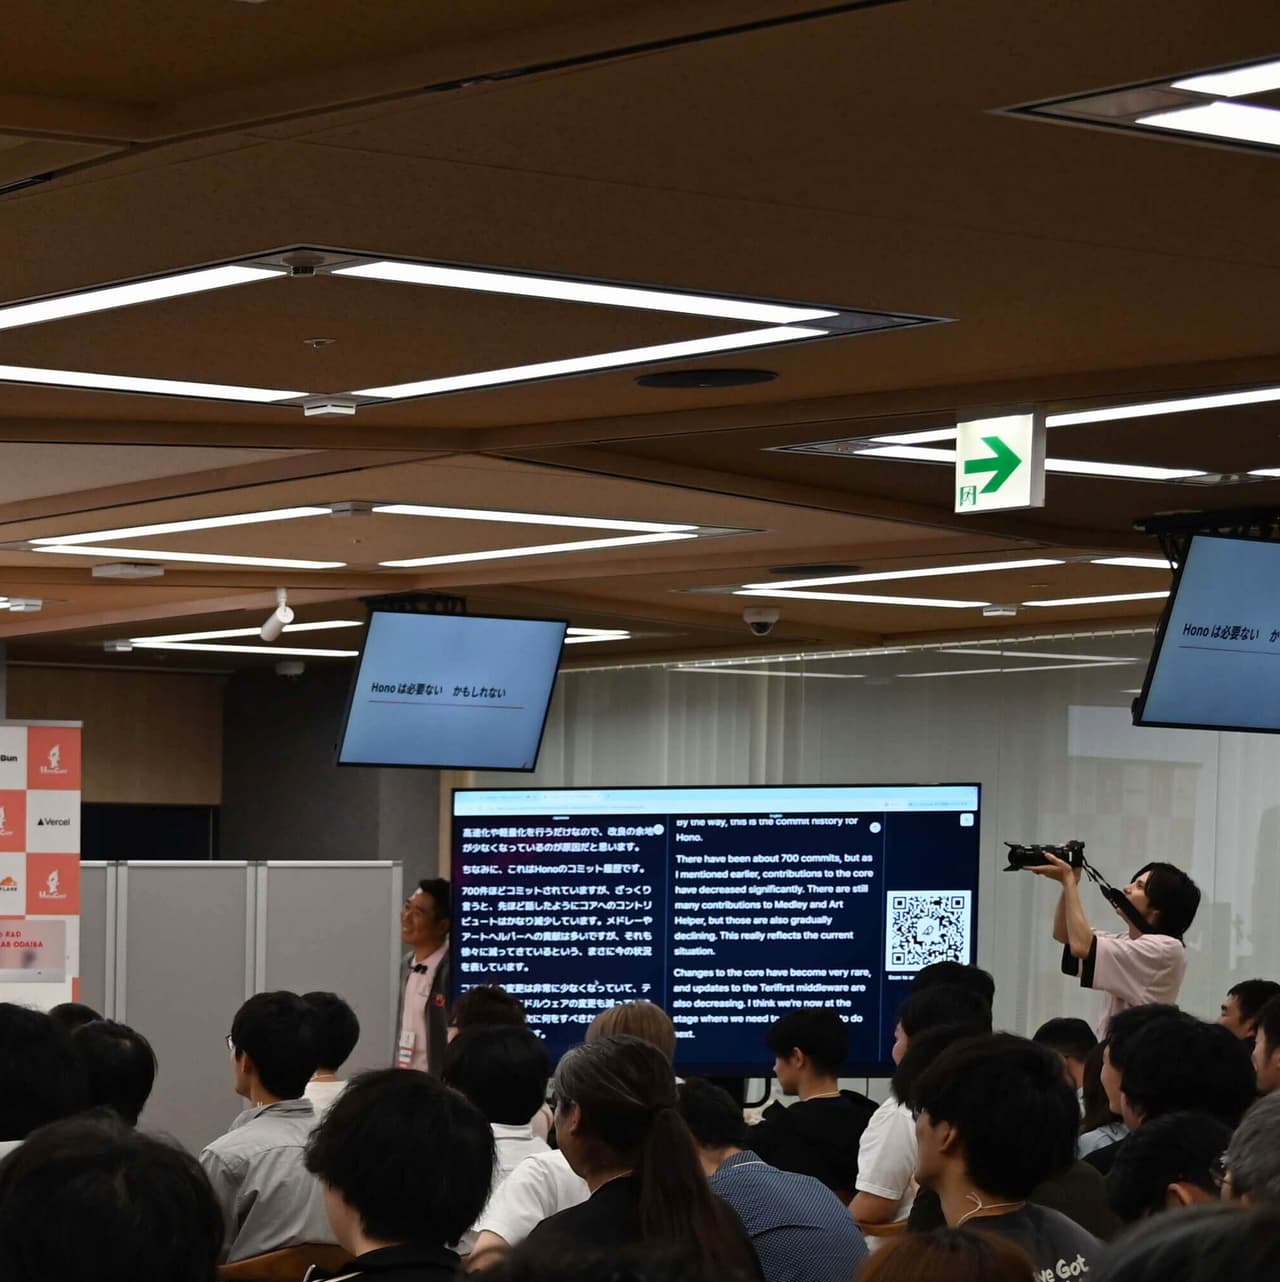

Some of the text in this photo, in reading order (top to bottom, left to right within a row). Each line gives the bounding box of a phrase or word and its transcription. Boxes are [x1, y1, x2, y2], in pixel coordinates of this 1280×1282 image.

[1183, 623, 1209, 636] Hono
[1210, 624, 1260, 641] は必要ない
[371, 682, 506, 698] Hono は必要ない かもしれない
[0, 754, 18, 762] Bun
[45, 818, 71, 826] Vercel
[675, 832, 704, 842] Hono.
[675, 853, 873, 864] There have been about 700 commits, but as
[730, 869, 761, 880] earlier,
[824, 869, 834, 878] to
[835, 868, 851, 878] the
[852, 870, 874, 878] core
[674, 885, 698, 895] have
[806, 884, 835, 894] There
[835, 885, 851, 894] are
[852, 883, 869, 894] still
[674, 902, 700, 912] many
[763, 900, 773, 910] to
[809, 899, 827, 909] and
[828, 899, 844, 909] Art
[674, 915, 706, 927] Helper,
[708, 915, 724, 925] but
[725, 915, 752, 925] those
[753, 917, 768, 925] are
[769, 915, 789, 925] also
[719, 930, 739, 941] This
[740, 930, 766, 942] really
[767, 930, 802, 940] reflects
[803, 930, 819, 940] the
[820, 931, 854, 940] current
[673, 967, 872, 980] Changes to the core have become very rare,
[673, 983, 691, 993] and
[692, 983, 730, 995] updates
[731, 983, 741, 993] to
[742, 983, 758, 993] the
[850, 984, 866, 992] are
[672, 999, 693, 1008] also
[752, 998, 776, 1008] think
[776, 998, 803, 1008] we're
[803, 999, 824, 1008] now
[824, 999, 835, 1008] at
[835, 998, 852, 1008] the
[673, 1014, 699, 1025] stage
[700, 1014, 729, 1024] where
[730, 1015, 744, 1024] we
[745, 1014, 769, 1023] need
[850, 1013, 863, 1023] do
[1055, 1253, 1089, 1279] Got
